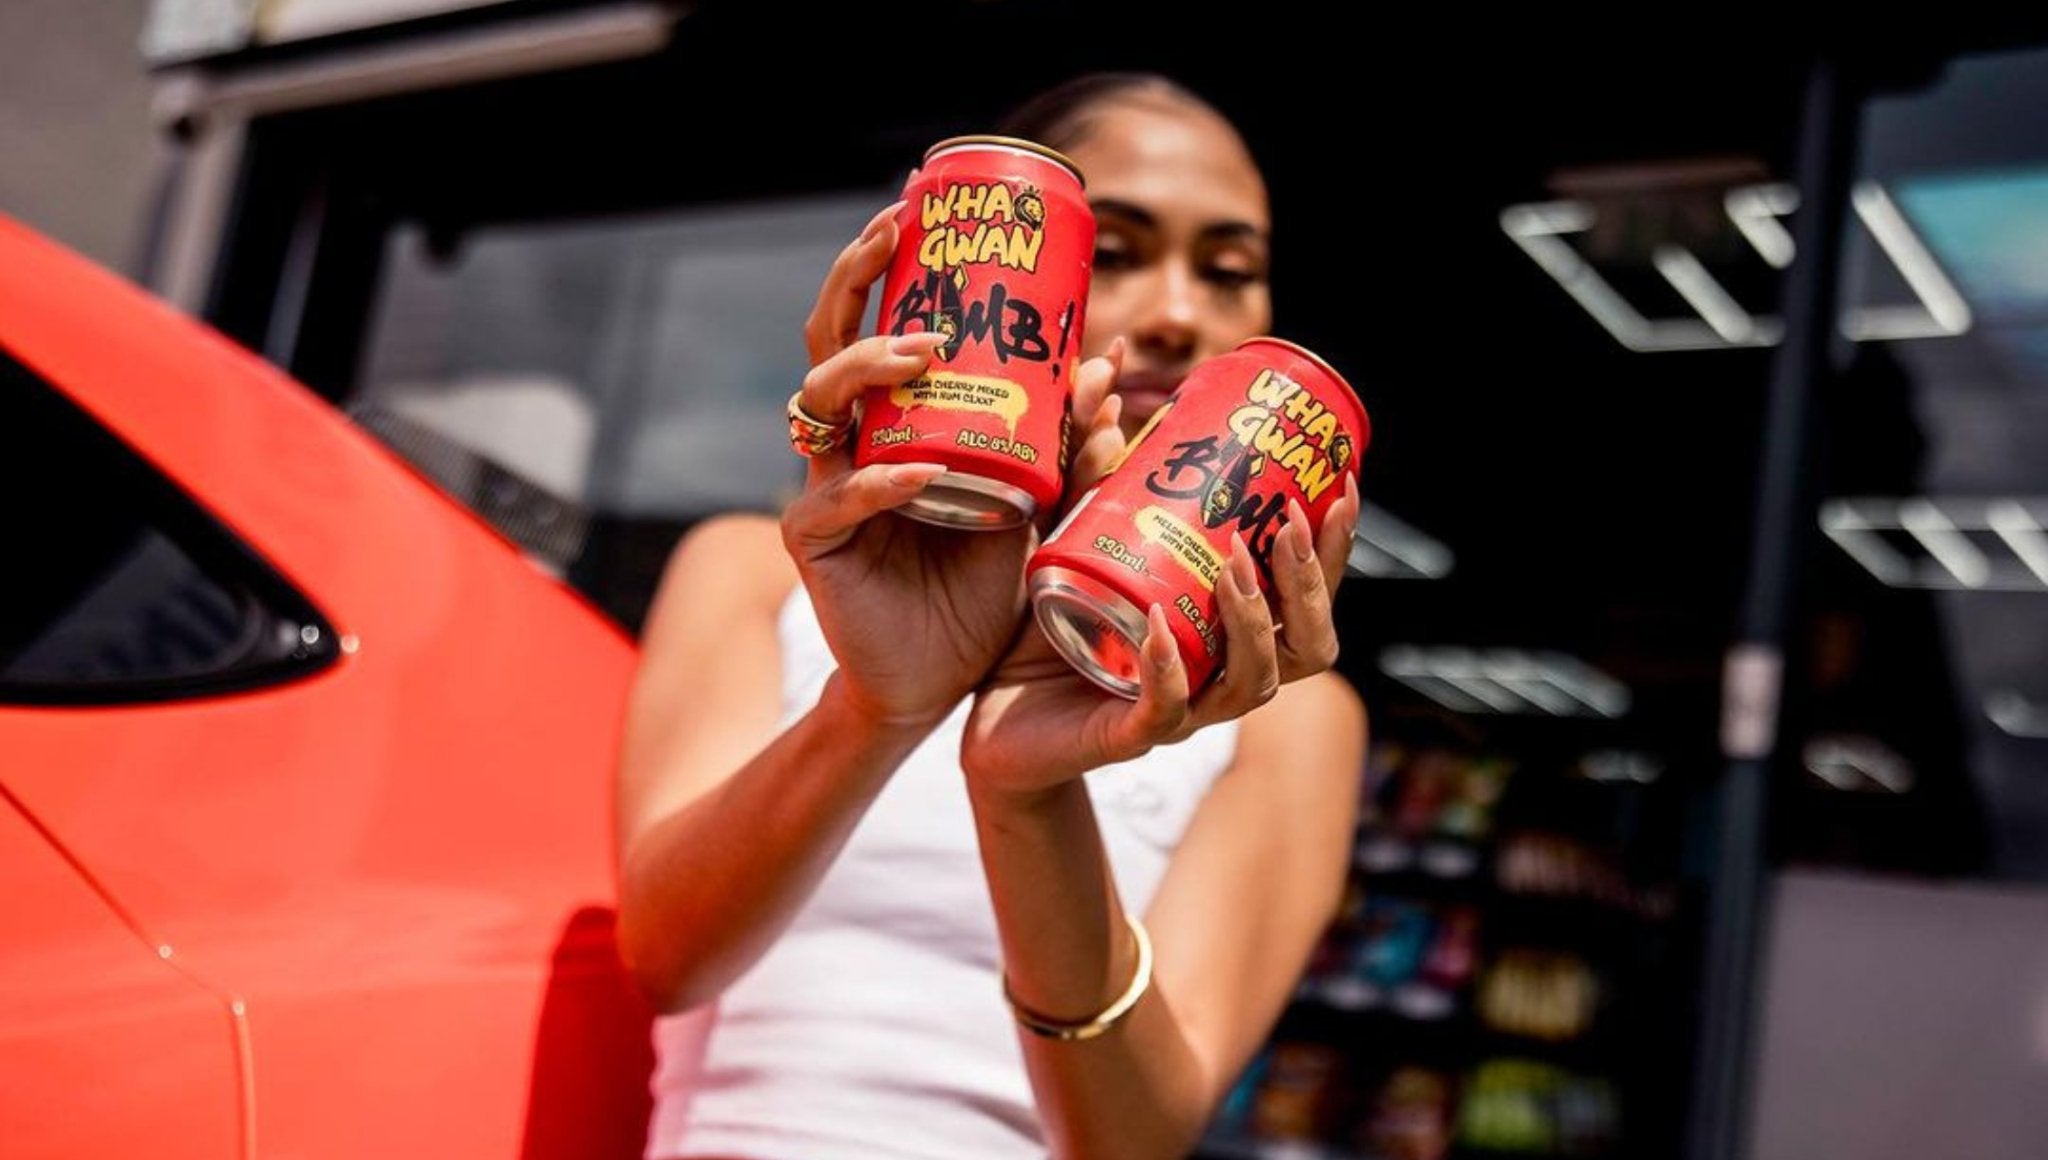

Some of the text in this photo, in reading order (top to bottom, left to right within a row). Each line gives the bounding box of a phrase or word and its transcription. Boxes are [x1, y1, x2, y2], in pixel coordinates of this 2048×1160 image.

[920, 182, 1015, 232] WHA
[918, 220, 1045, 274] GWAN
[913, 390, 937, 400] WITH
[940, 391, 960, 401] RUM
[934, 380, 975, 393] CHERRY
[976, 385, 1010, 399] MIXED
[1245, 367, 1338, 452] WHA
[955, 427, 1040, 465] ALC 8% ABV
[1229, 404, 1337, 503] GWAN
[1092, 534, 1147, 574] 330ml
[1153, 514, 1216, 568] MELON CHERRY
[1160, 531, 1184, 552] WITH
[1183, 548, 1202, 568] RUM
[1173, 592, 1200, 624] ALC
